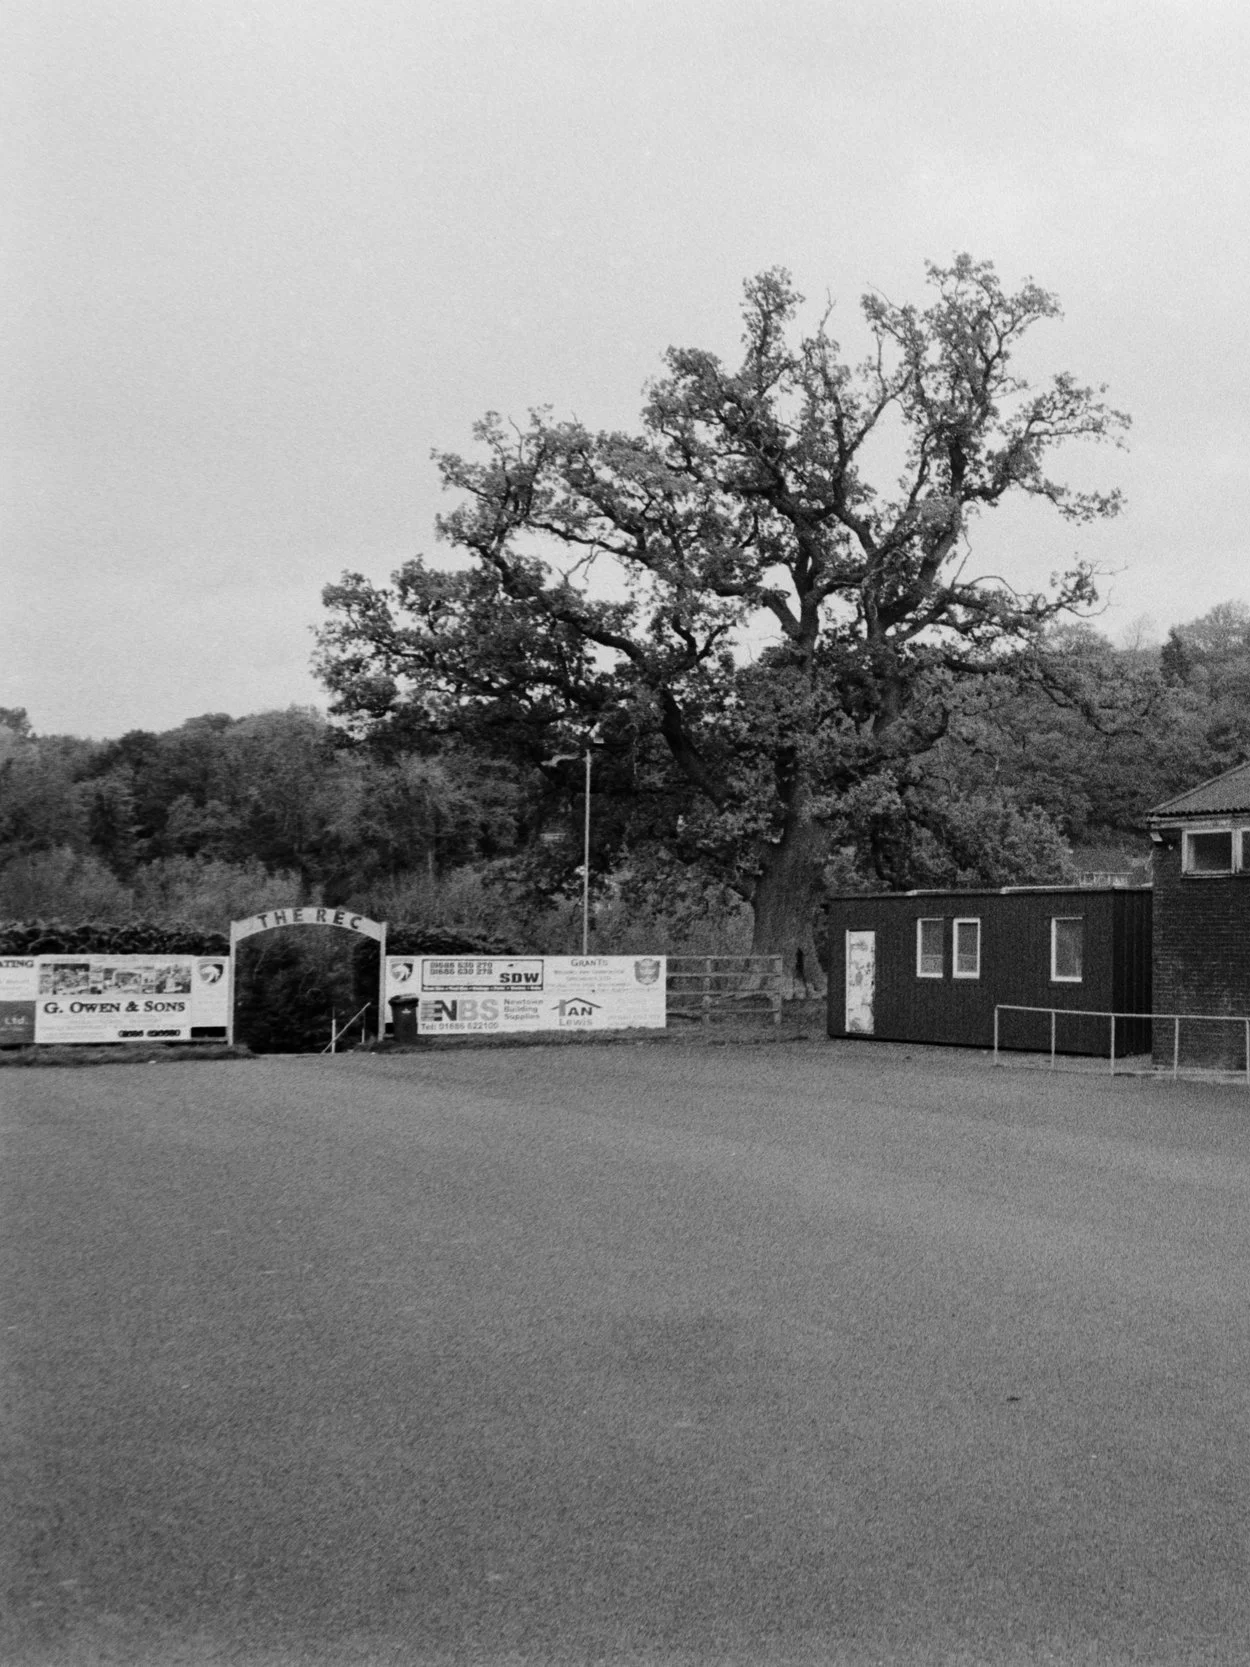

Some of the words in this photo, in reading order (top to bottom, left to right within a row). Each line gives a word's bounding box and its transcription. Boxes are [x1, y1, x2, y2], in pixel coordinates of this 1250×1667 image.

[257, 908, 303, 928] THE
[316, 908, 362, 929] REC
[499, 972, 539, 983] SDW
[43, 1002, 63, 1014] G.
[69, 1001, 121, 1014] OWEN
[125, 1001, 139, 1013] &
[144, 1001, 186, 1013] SONS
[421, 999, 499, 1022] NBS
[4, 1015, 29, 1025] Ltd.
[559, 1018, 593, 1026] Lewis
